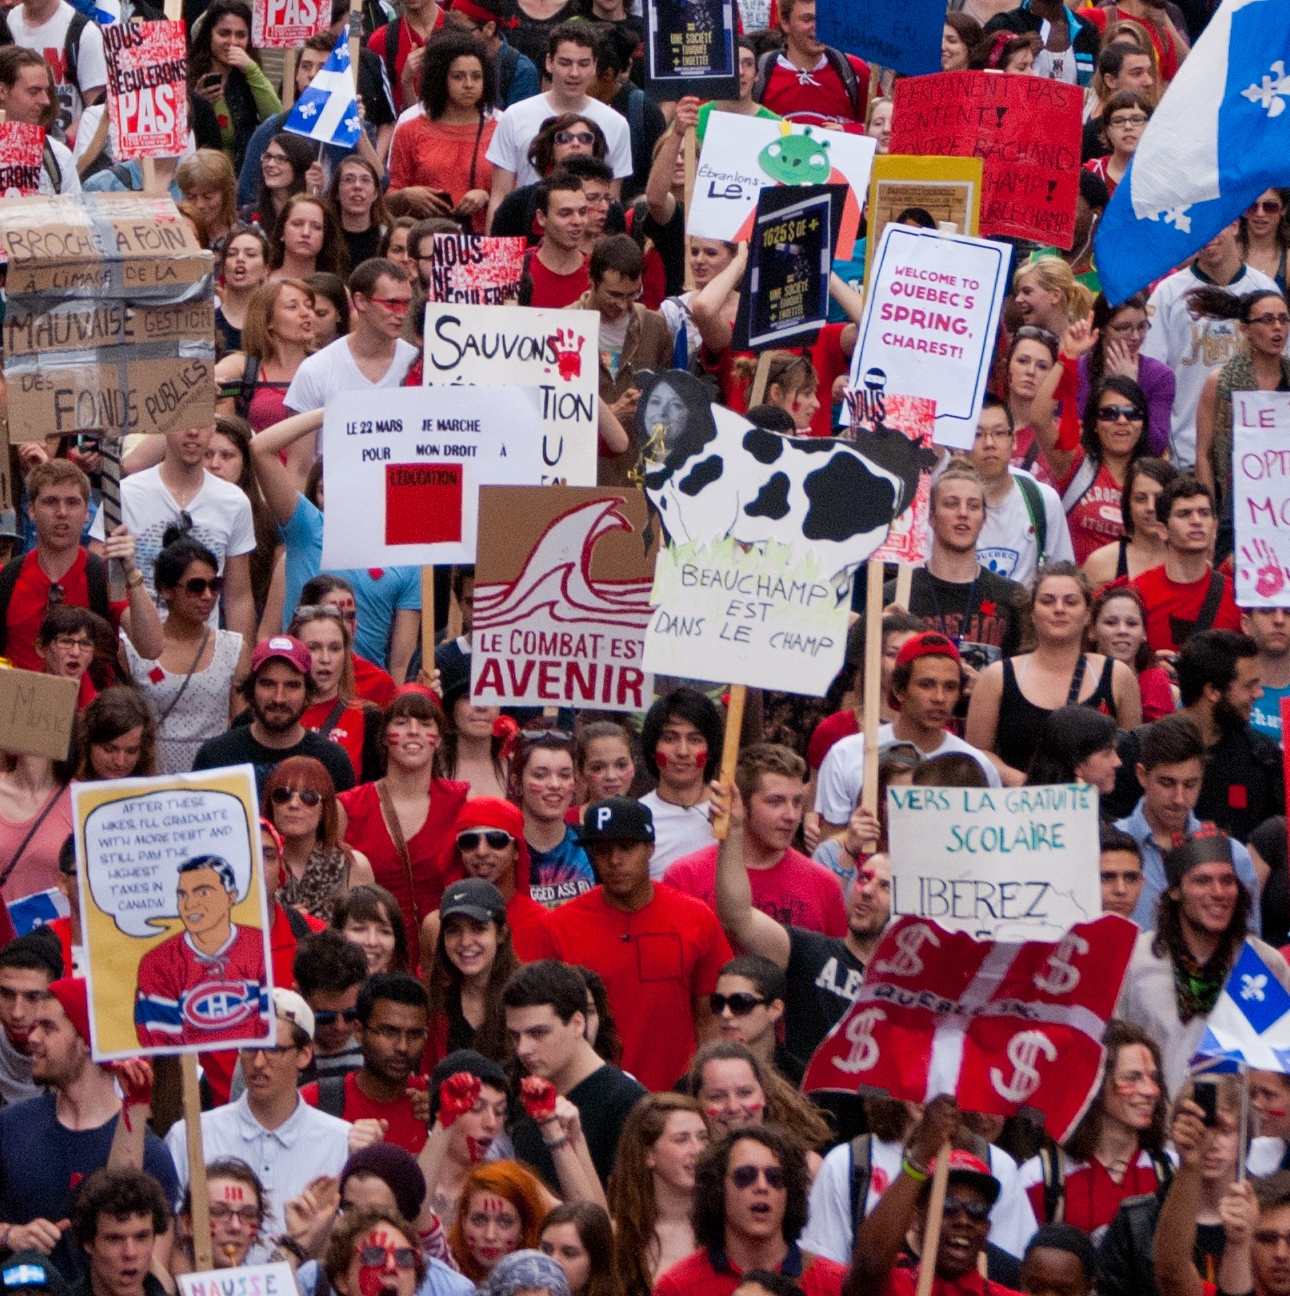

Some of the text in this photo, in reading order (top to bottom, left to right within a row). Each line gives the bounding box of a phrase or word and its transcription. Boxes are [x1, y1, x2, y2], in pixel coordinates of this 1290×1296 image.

[118, 88, 178, 135] PAS
[126, 266, 176, 281] DE LA
[895, 268, 979, 290] WELCOME TO
[9, 310, 135, 351] MAUVAISE
[880, 303, 973, 338] SPRING,
[881, 331, 963, 359] CHAREST!
[54, 389, 139, 430] FONDS
[1241, 401, 1275, 428] LE
[360, 419, 481, 434] 22 MARS JE MARCHE
[362, 444, 478, 462] POUR MON DROIT
[682, 563, 827, 603] BEAUCHAMP
[727, 600, 774, 622] EST
[480, 630, 644, 660] LE COMBAT EST
[654, 611, 834, 657] DANS LE CHAMP
[473, 659, 644, 708] AVENIR
[122, 796, 206, 814] AFTER THESE
[891, 785, 1091, 814] VERS LA GRATUITÉ
[162, 809, 228, 826] GRADUATE
[98, 825, 233, 848] WITH MORE DEBT AND
[99, 846, 189, 865] STILL PAY THE
[108, 865, 159, 879] HIGHEST
[110, 883, 149, 896] TAXES
[891, 869, 1049, 921] LIBÉREZ
